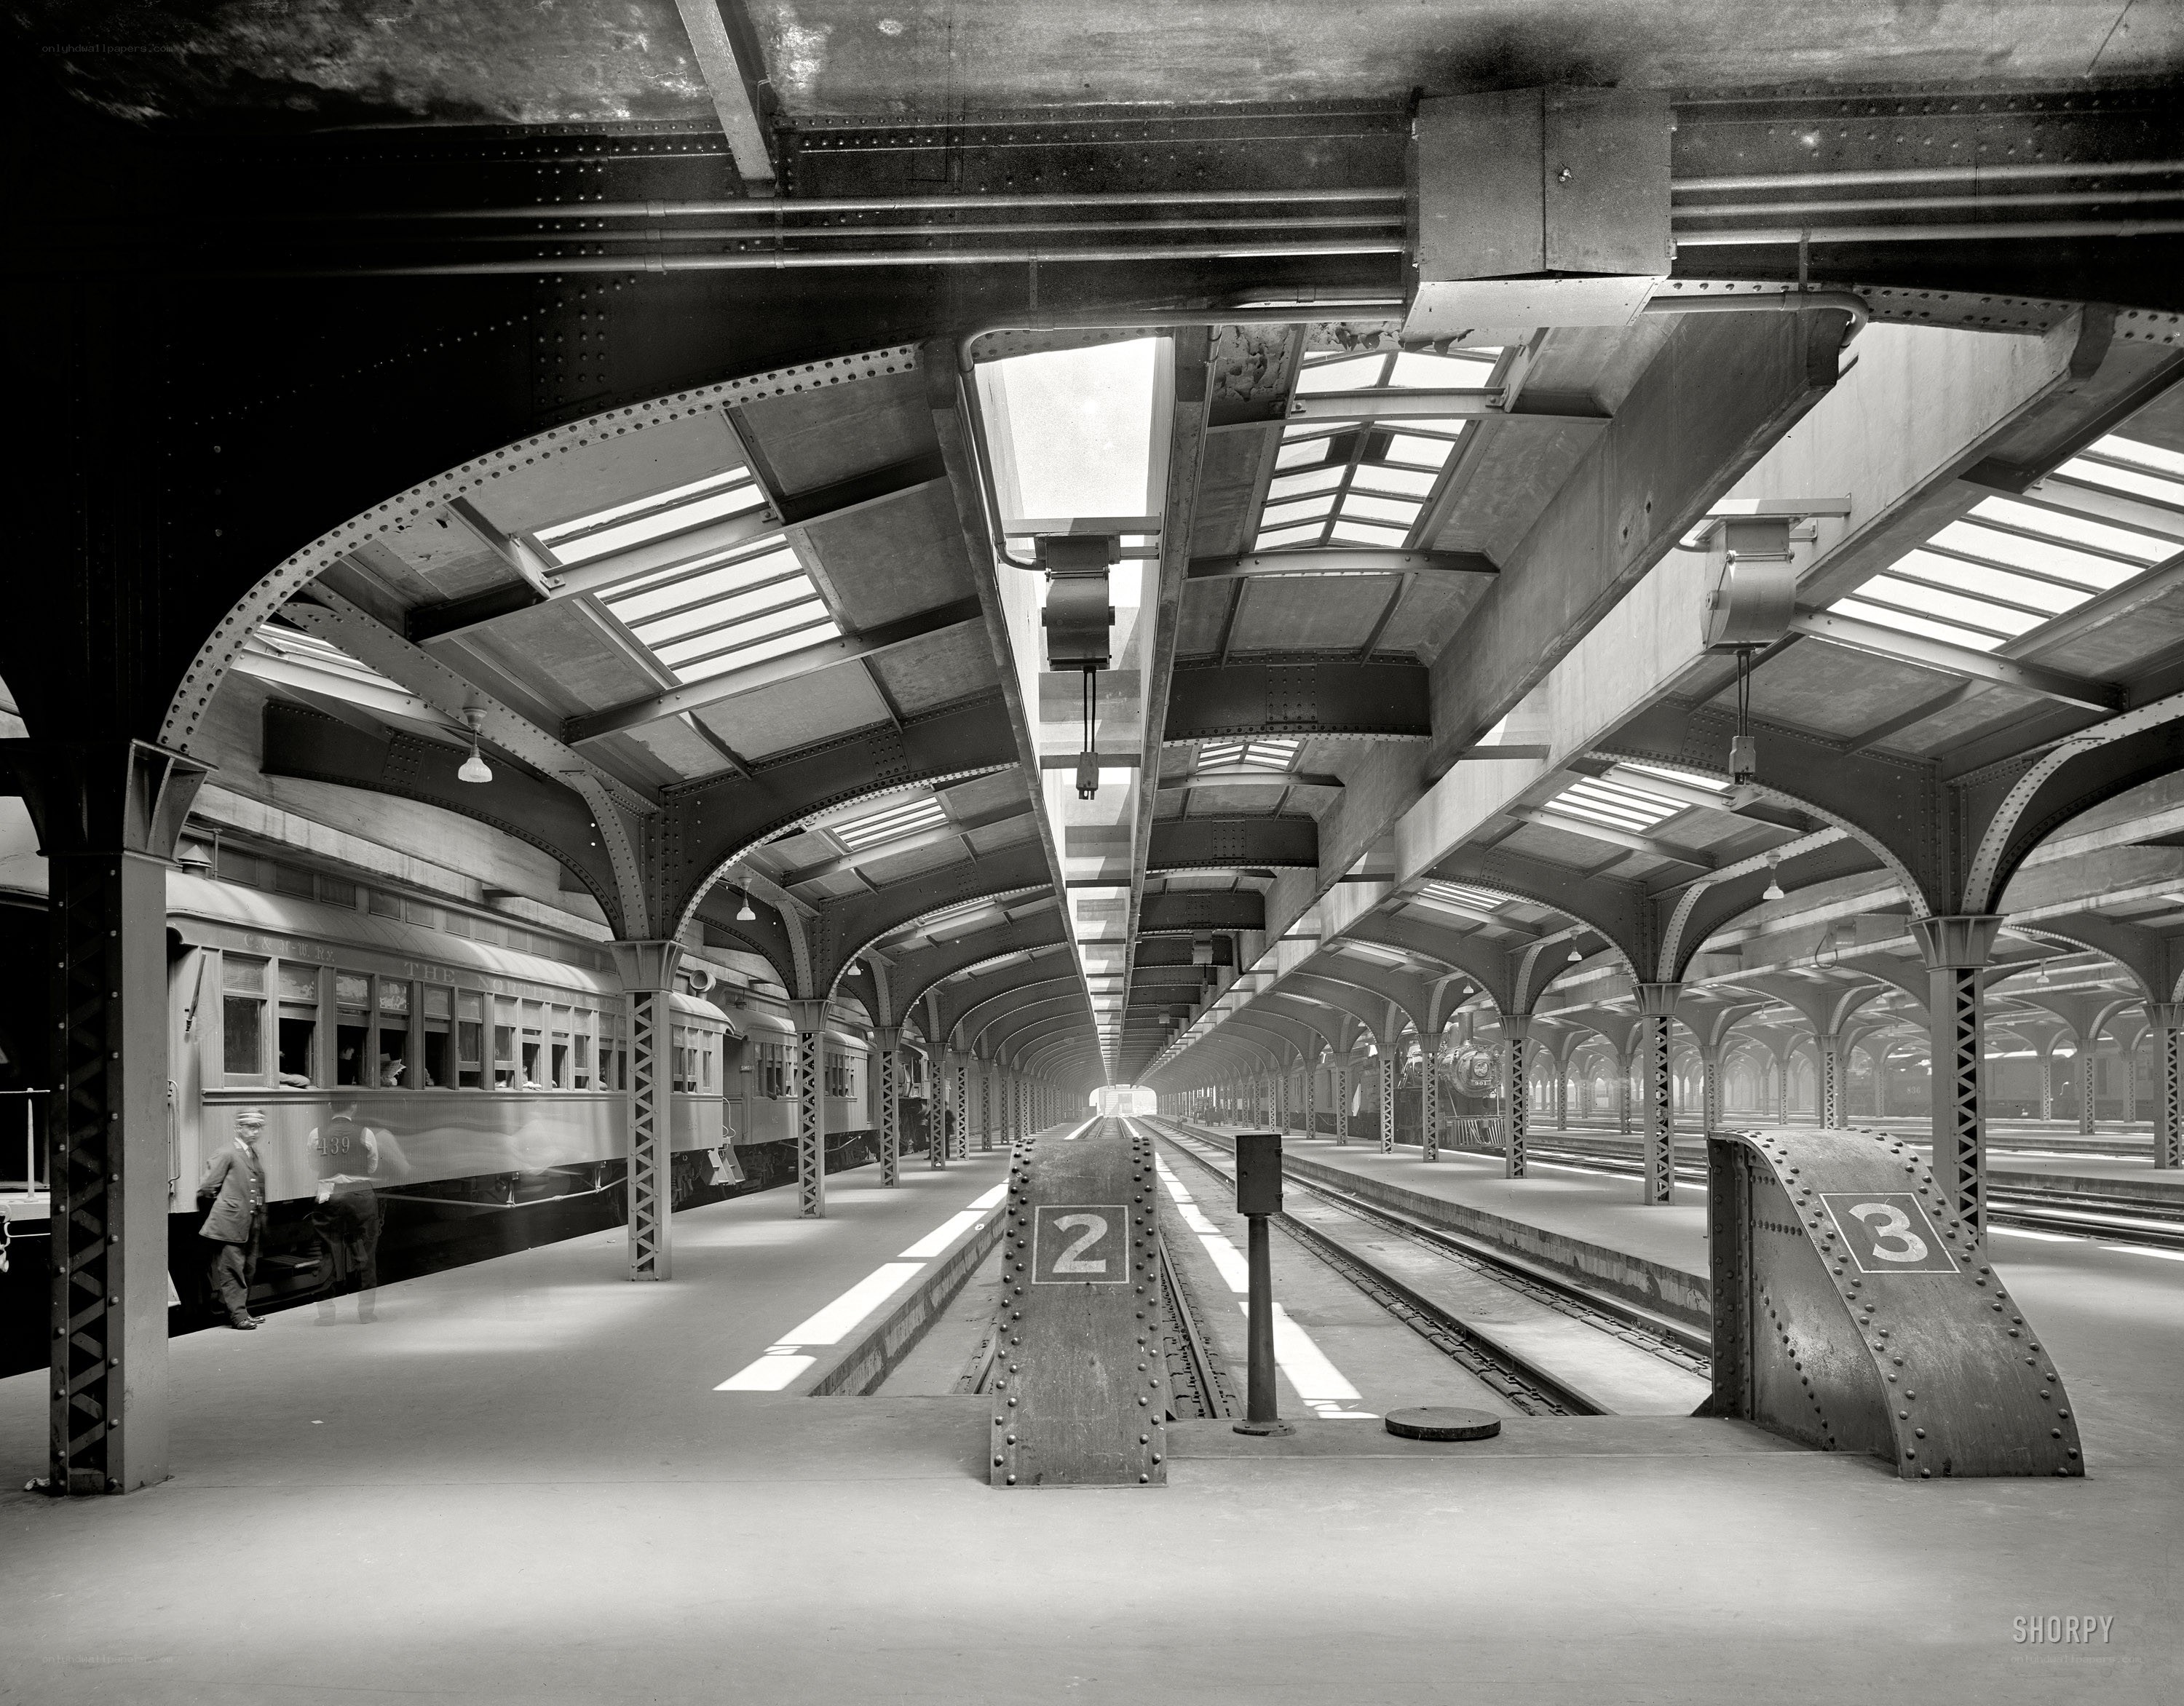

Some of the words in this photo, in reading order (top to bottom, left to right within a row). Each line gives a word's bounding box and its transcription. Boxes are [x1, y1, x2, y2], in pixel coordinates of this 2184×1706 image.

[262, 937, 272, 951] &
[404, 962, 455, 982] THE
[317, 1136, 349, 1156] 439
[1848, 1203, 1928, 1262] 3
[1053, 1214, 1107, 1273] 2
